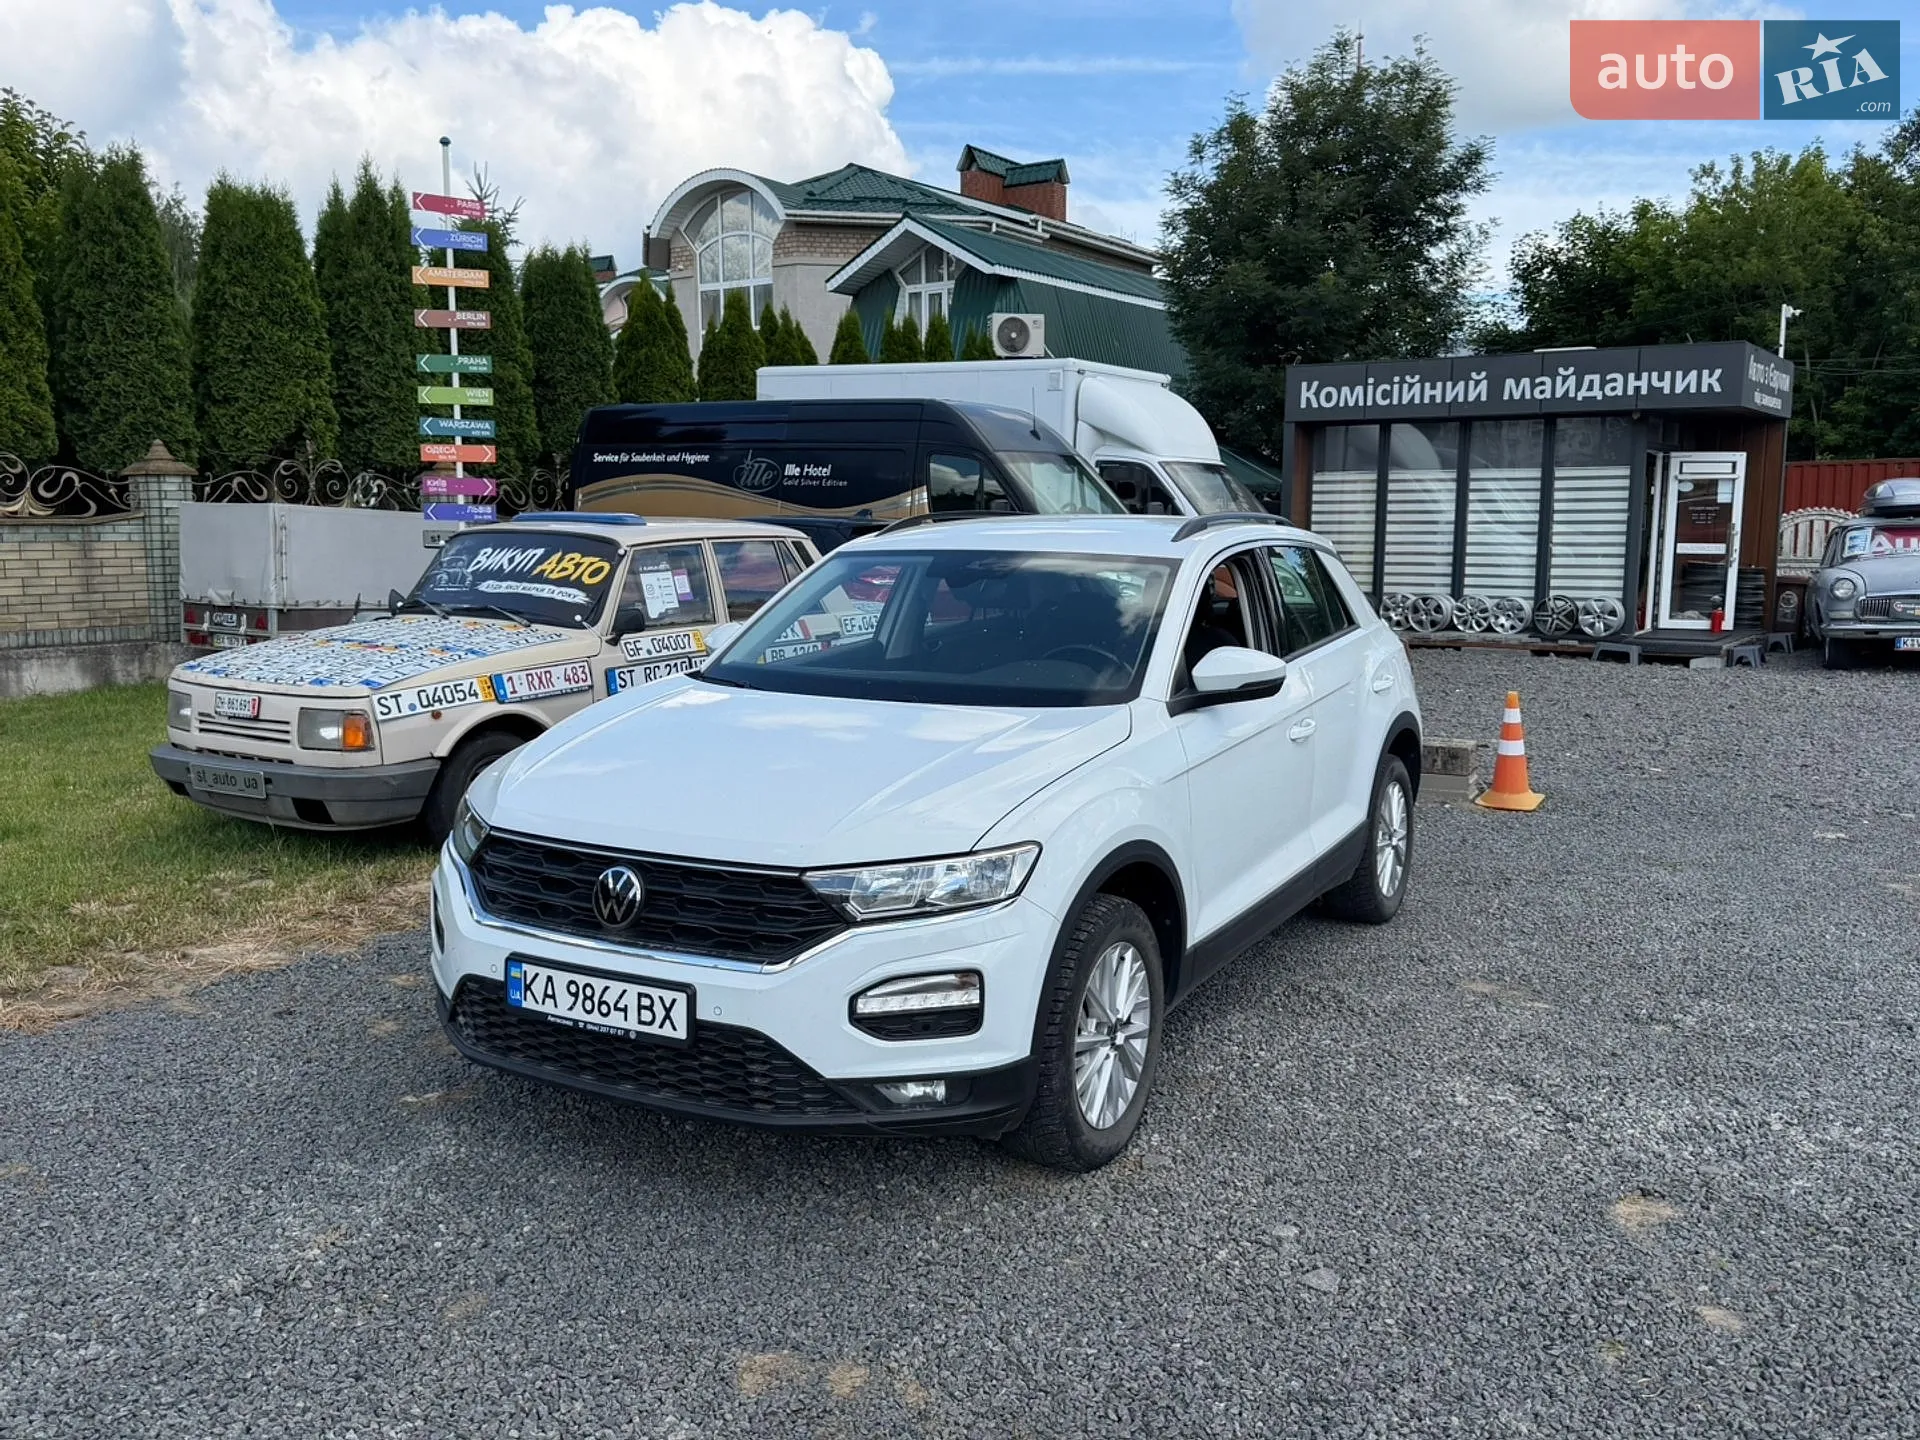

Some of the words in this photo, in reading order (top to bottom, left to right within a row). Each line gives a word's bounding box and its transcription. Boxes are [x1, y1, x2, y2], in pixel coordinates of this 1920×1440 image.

[456, 200, 481, 210] PARIS
[427, 269, 484, 280] AMSTERDAM
[455, 311, 486, 321] BERLIN
[457, 357, 488, 366] PRAHA
[465, 388, 489, 398] WIEN
[1300, 371, 1488, 409] Комісійний
[1502, 366, 1723, 401] майданчик
[438, 420, 491, 430] WARSZAWA
[593, 452, 619, 462] Service
[619, 452, 630, 464] für
[630, 452, 666, 462] Sauberkeit
[666, 452, 681, 462] und
[681, 452, 710, 464] Hygiene
[803, 463, 832, 476] Hotel
[782, 477, 800, 486] Gold
[800, 478, 820, 486] Silver
[822, 478, 848, 487] Edition
[467, 547, 545, 573] ВИКУП
[532, 551, 611, 585] АВТО
[624, 640, 643, 657] GF
[526, 670, 555, 691] RXR
[563, 665, 588, 685] 483
[618, 669, 635, 688] ST
[378, 694, 402, 716] ST
[523, 970, 558, 1009] KA
[566, 979, 628, 1022] 9864
[637, 992, 678, 1032] BX
